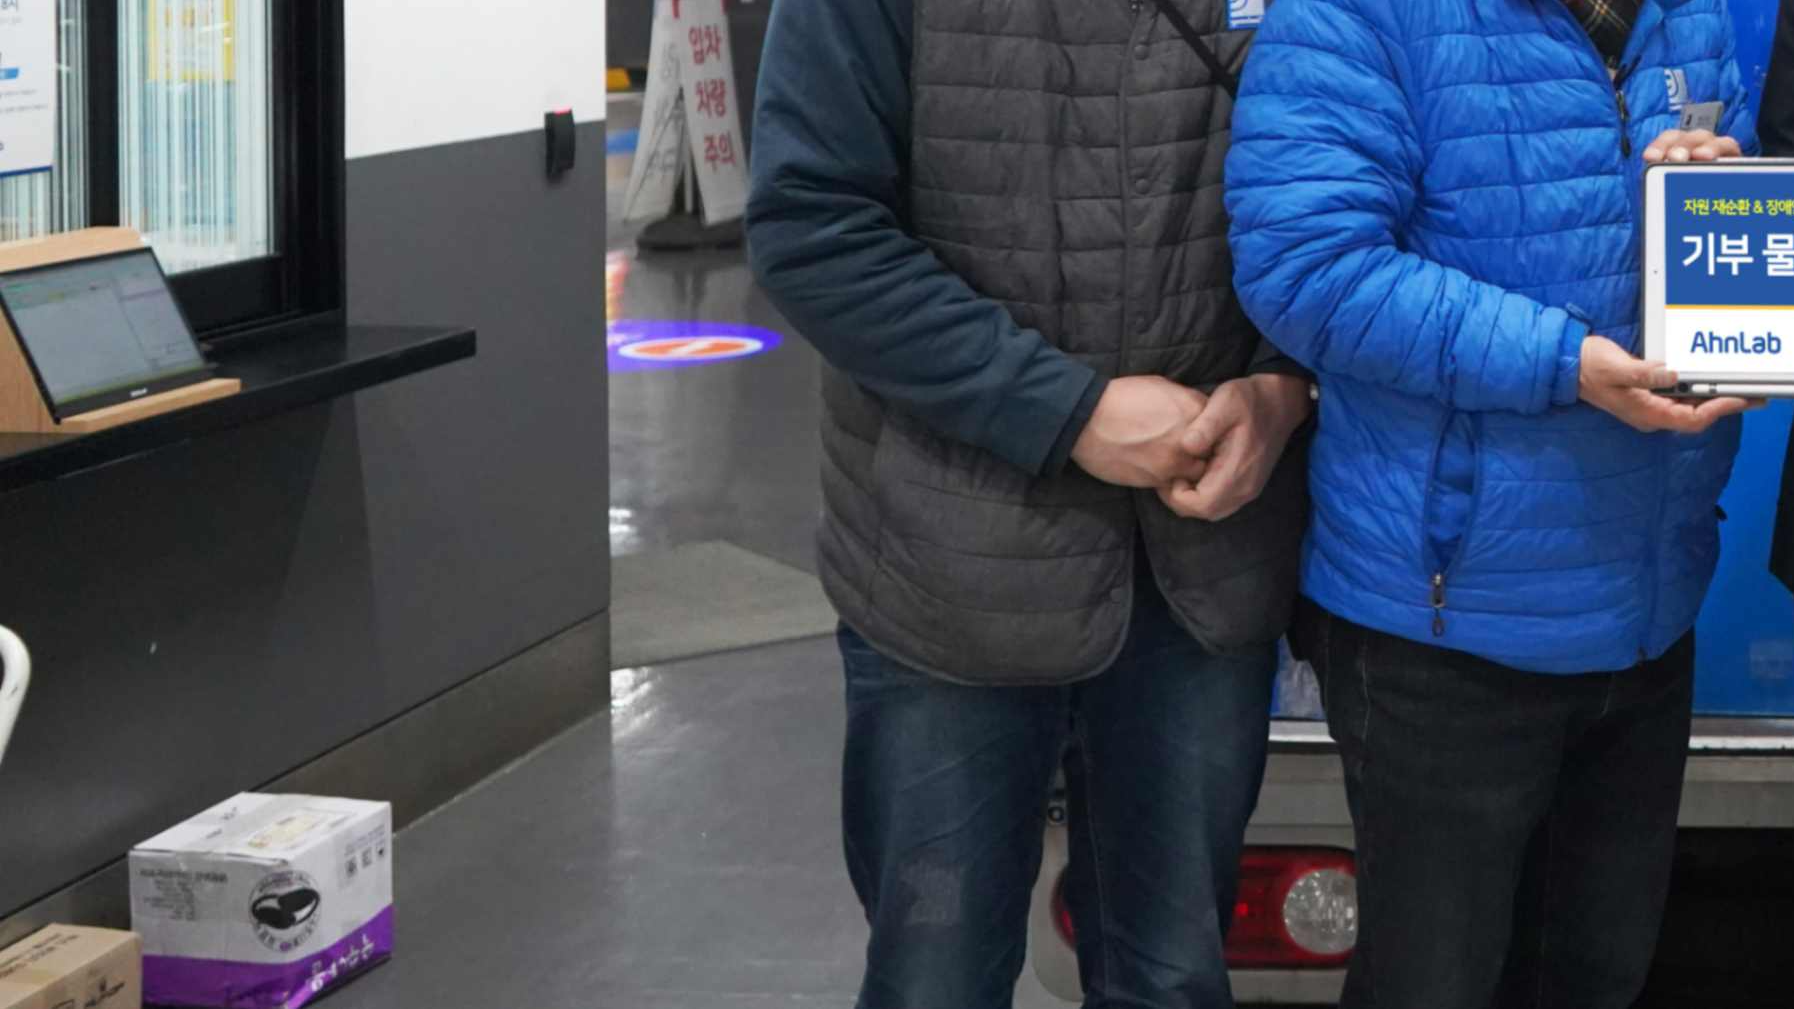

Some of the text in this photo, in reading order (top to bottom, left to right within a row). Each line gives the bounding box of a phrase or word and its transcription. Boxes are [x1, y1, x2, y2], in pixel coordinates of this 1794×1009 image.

[688, 25, 721, 66] 입차
[703, 131, 736, 172] 주의
[1683, 198, 1710, 216] 자원
[1712, 198, 1750, 216] 재순환
[1753, 199, 1764, 215] &
[1682, 232, 1754, 276] 기부
[1690, 331, 1782, 354] AhnLab
